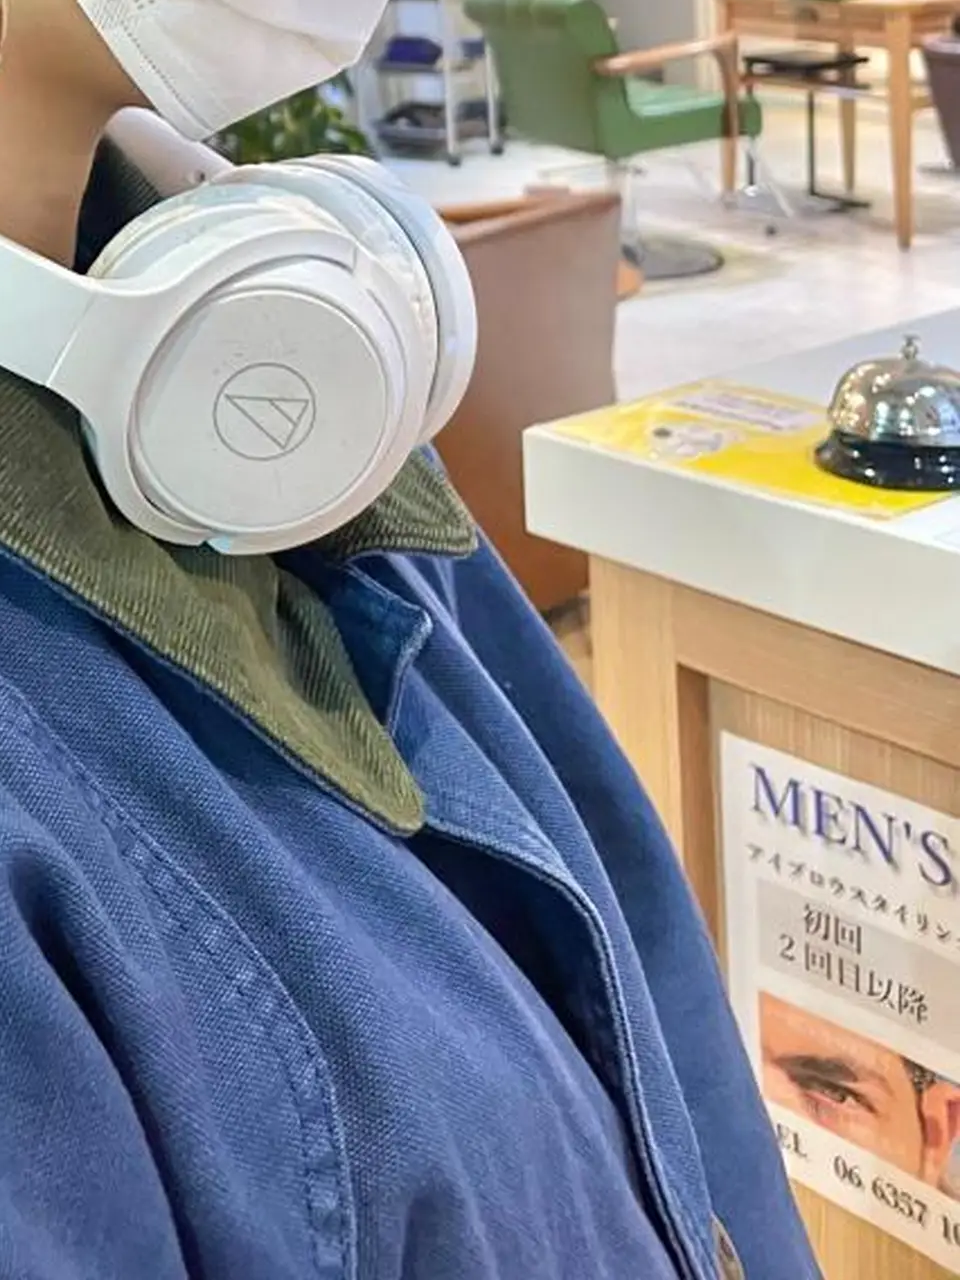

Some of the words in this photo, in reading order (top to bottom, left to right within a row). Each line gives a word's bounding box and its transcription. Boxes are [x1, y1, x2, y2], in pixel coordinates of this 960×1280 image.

[750, 762, 954, 887] MEN'S
[747, 843, 960, 948] アイブロウスタイリン
[804, 903, 862, 955] 初回
[776, 1122, 807, 1158] EL
[833, 1154, 863, 1189] 06
[871, 1176, 928, 1225] 6357
